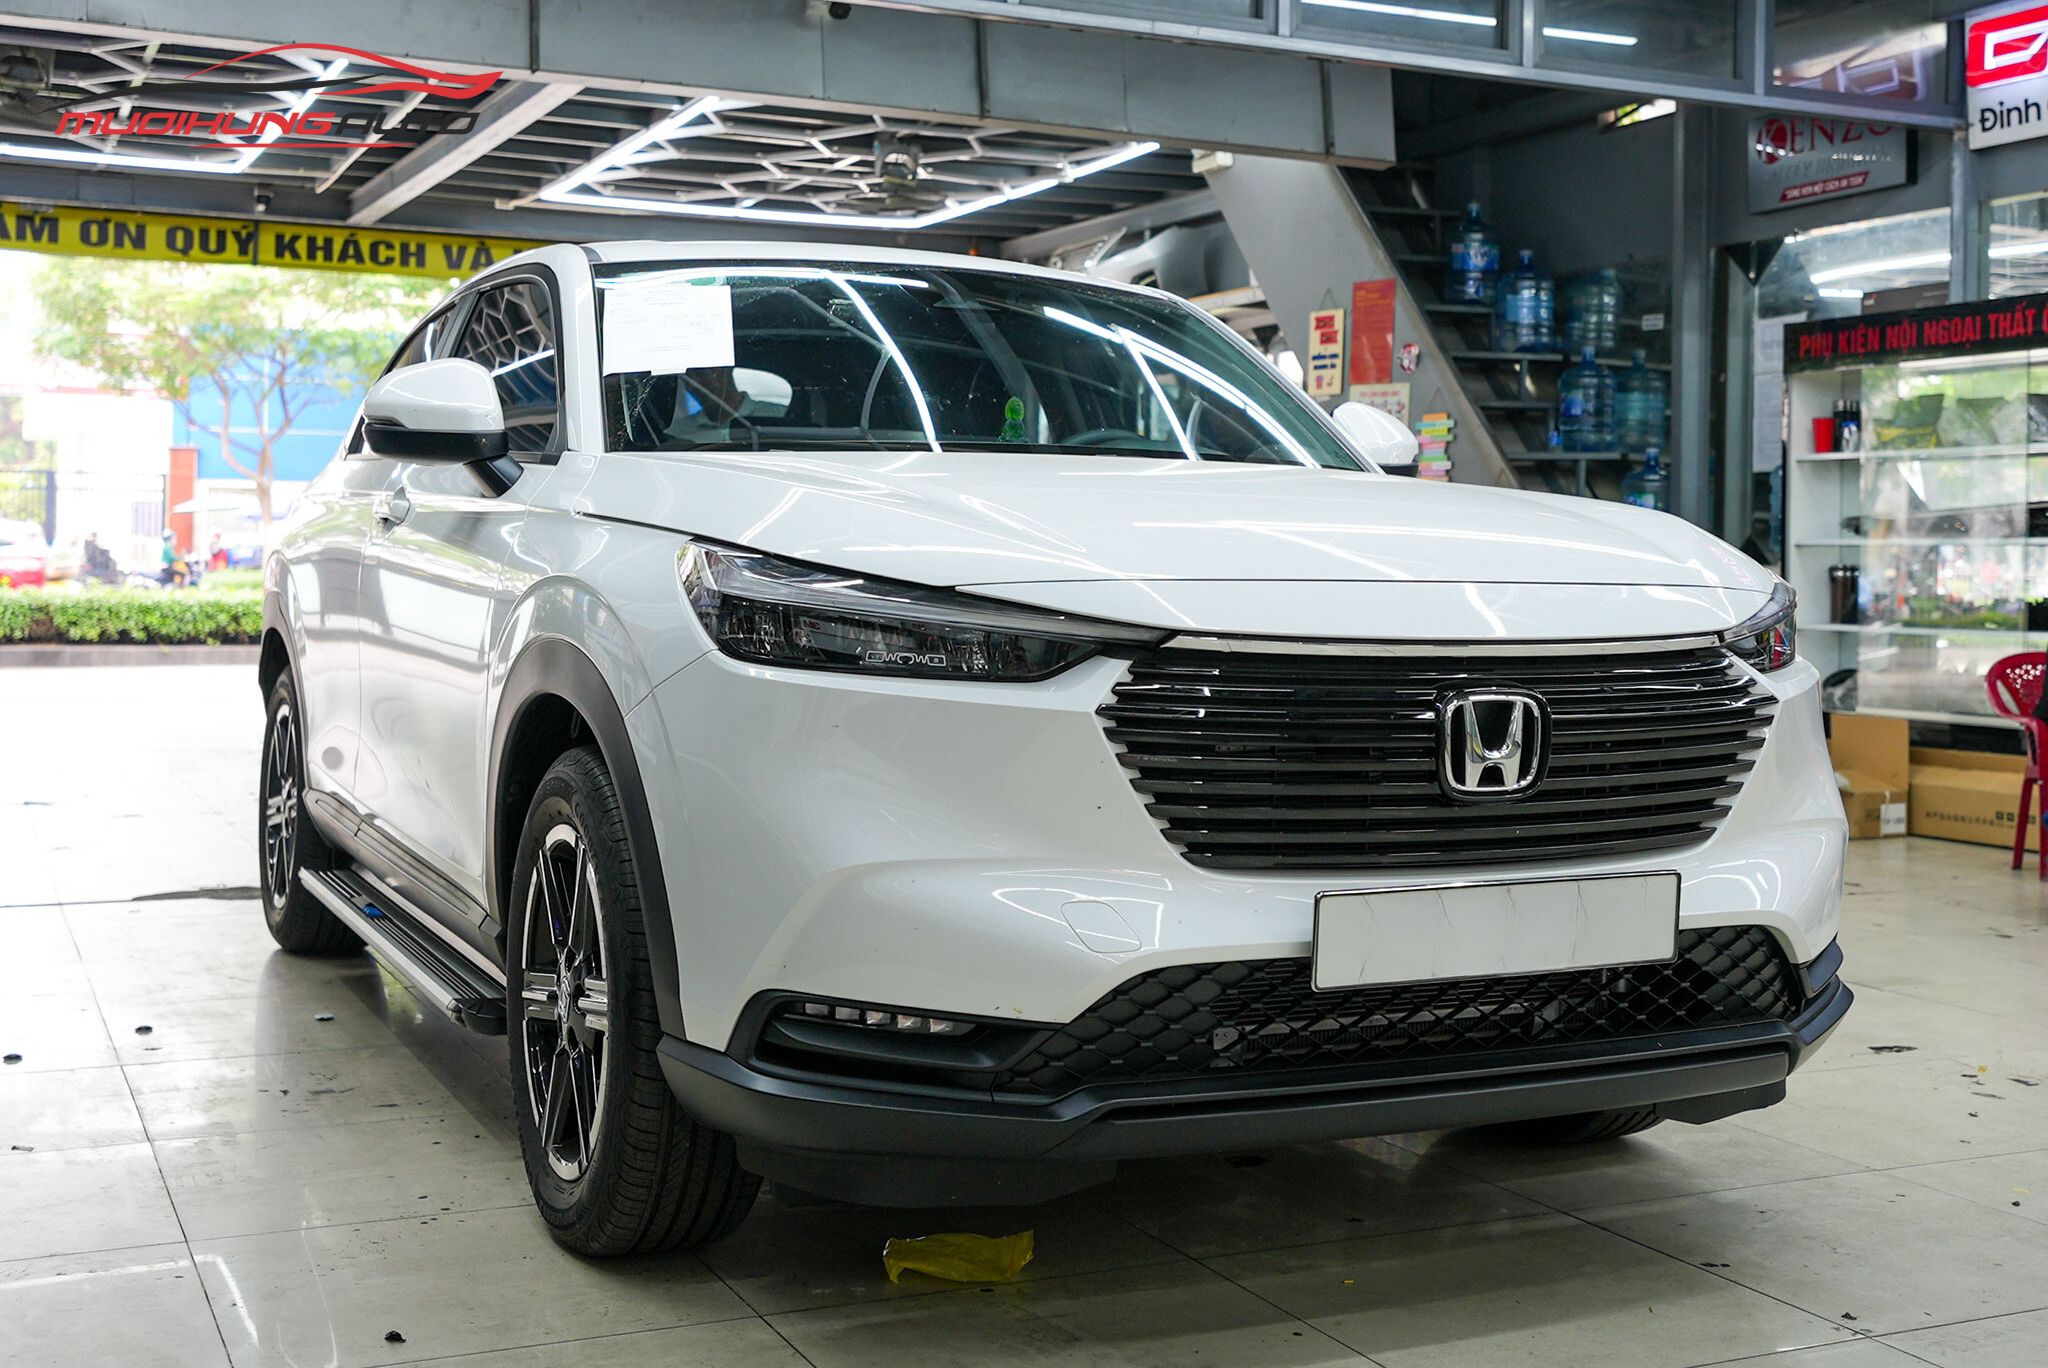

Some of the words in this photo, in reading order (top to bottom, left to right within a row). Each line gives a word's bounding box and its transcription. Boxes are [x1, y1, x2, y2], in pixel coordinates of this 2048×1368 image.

[79, 217, 146, 250] ƠN
[166, 224, 255, 258] QUÝ
[275, 233, 427, 269] KHÁCH
[442, 240, 496, 271] VÀ
[1800, 331, 1833, 363] PHỤ
[1838, 323, 1880, 358] KIỆN
[1885, 318, 1918, 354] NỘI
[1923, 314, 1982, 348] NGOẠI
[1988, 301, 2037, 340] THẤT
